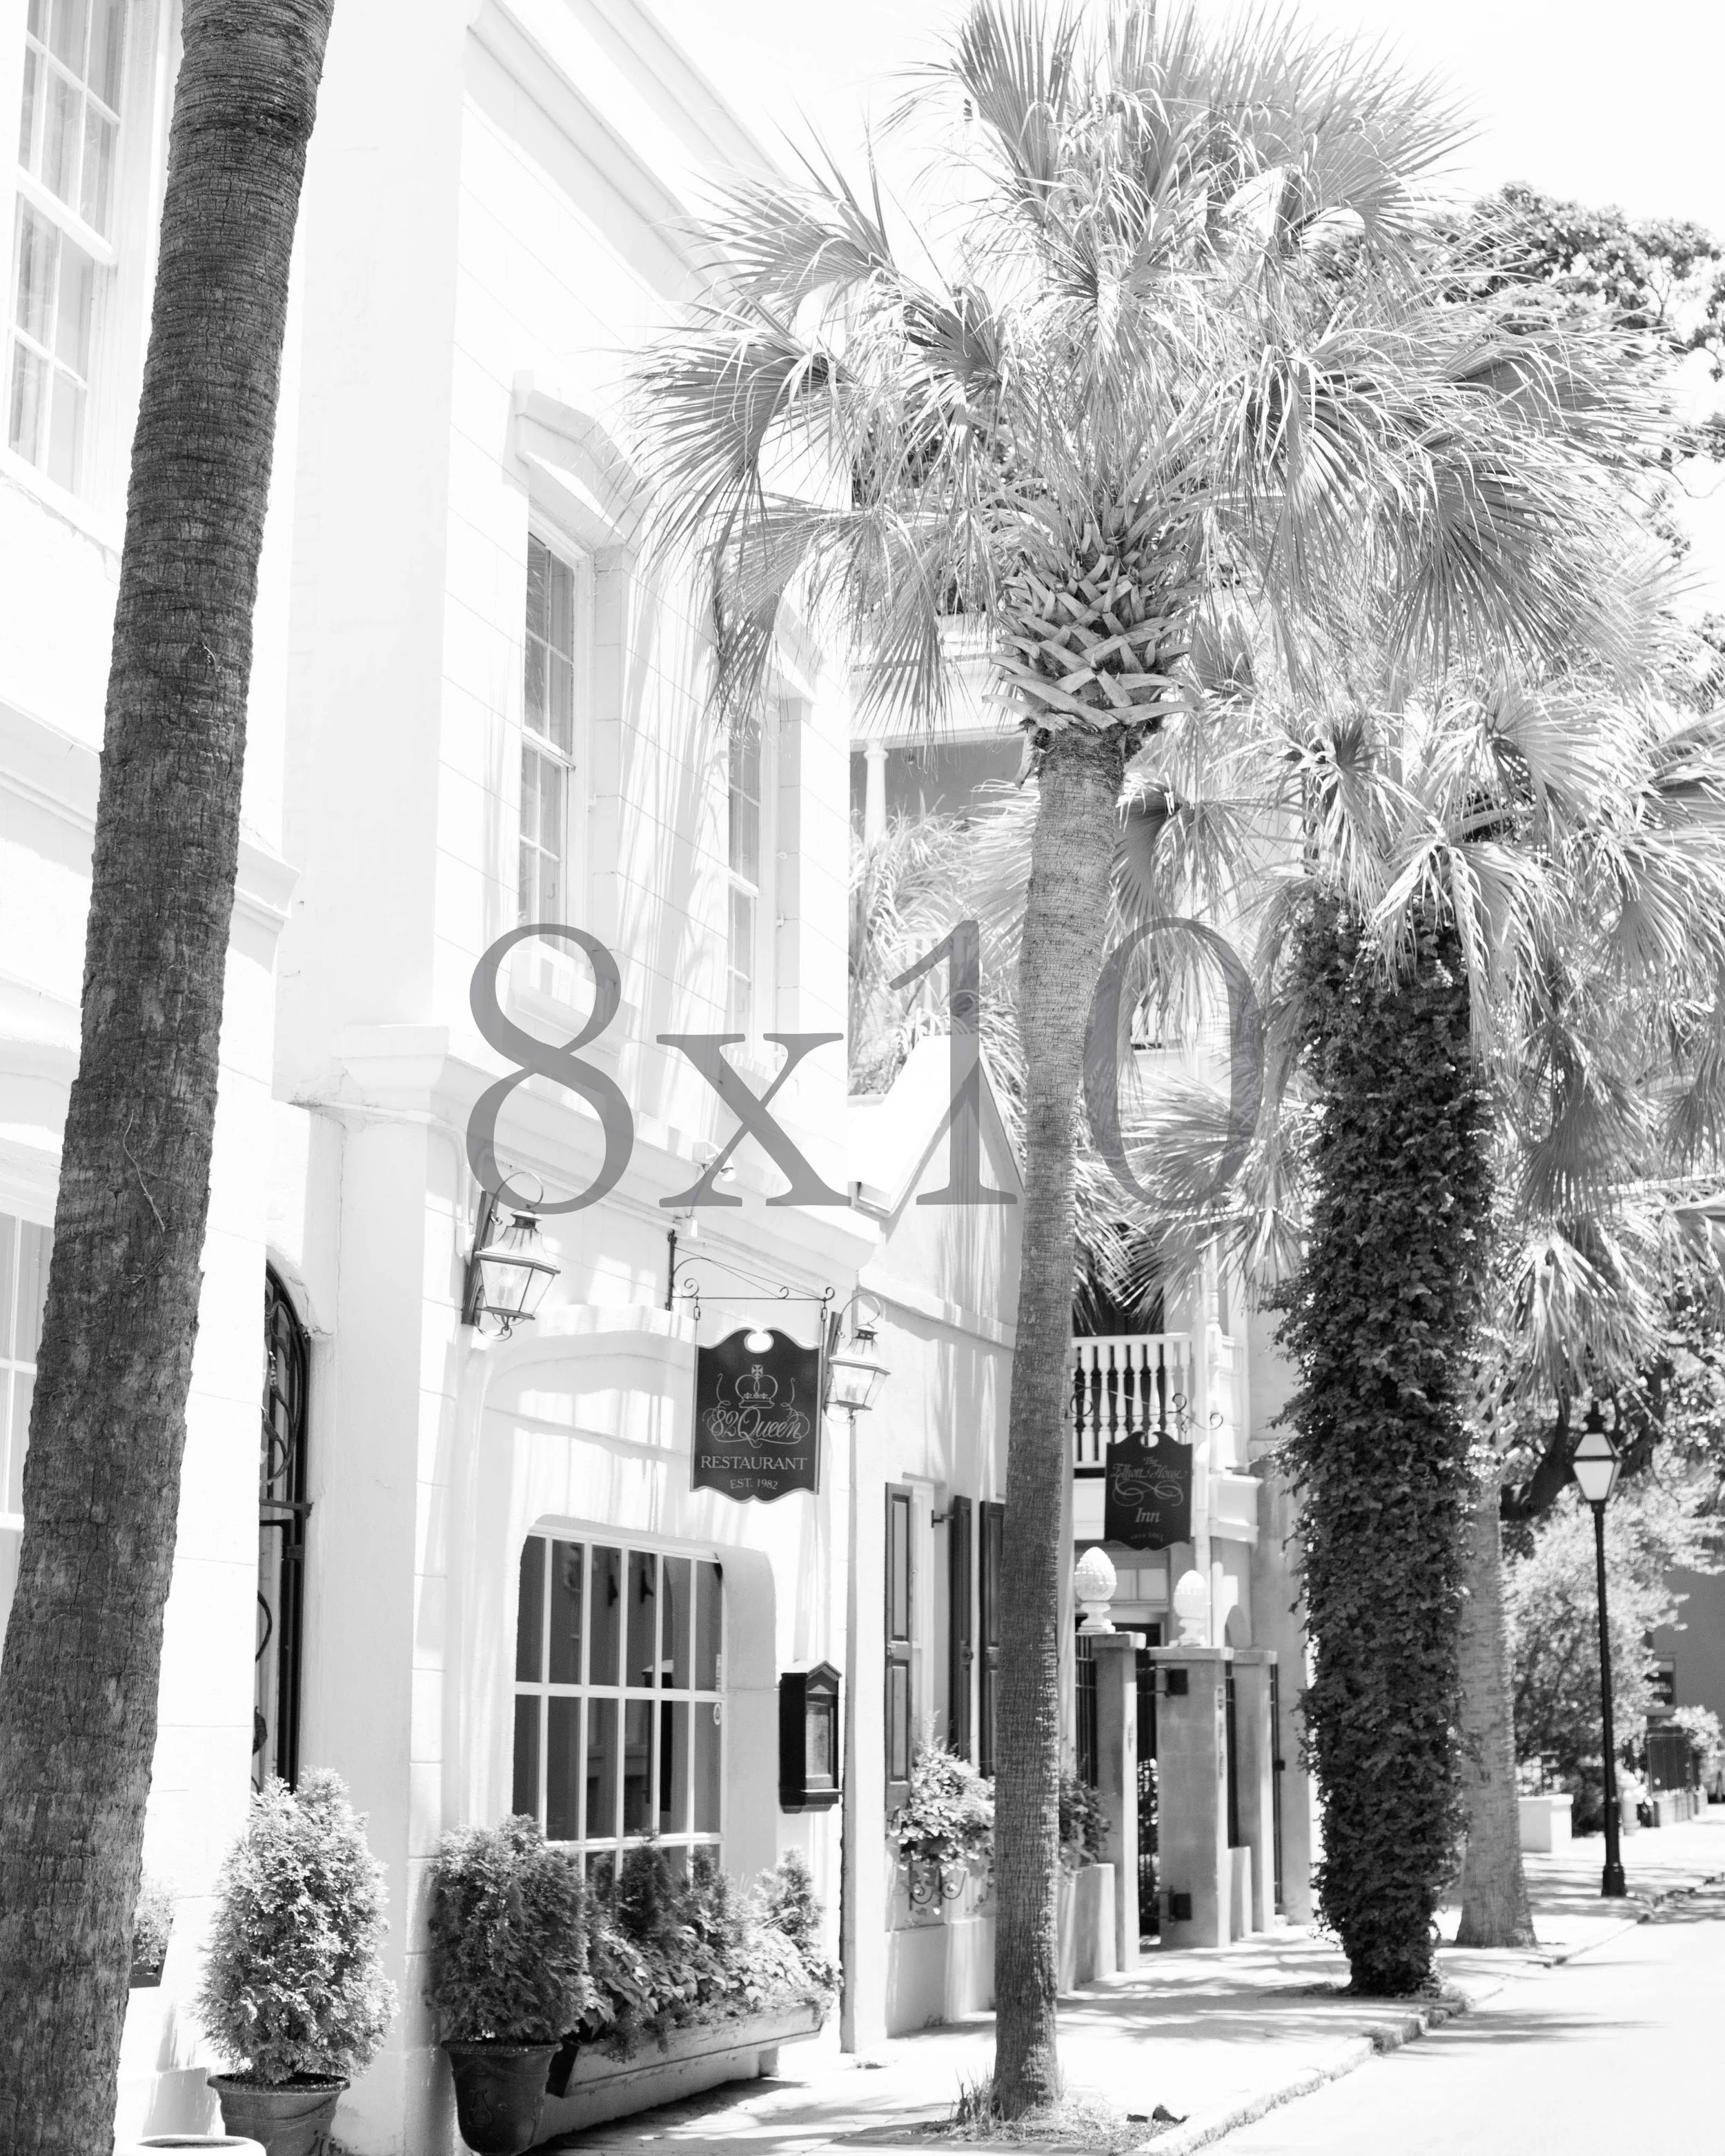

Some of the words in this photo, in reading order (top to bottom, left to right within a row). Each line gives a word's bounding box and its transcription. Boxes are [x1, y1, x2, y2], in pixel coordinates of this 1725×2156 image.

[711, 1410, 739, 1437] 82
[738, 1406, 802, 1446] Queen
[700, 1456, 807, 1470] RESTAURANT
[729, 1478, 753, 1490] EST.
[757, 1478, 778, 1490] 1982
[1135, 1507, 1161, 1523] Inn
